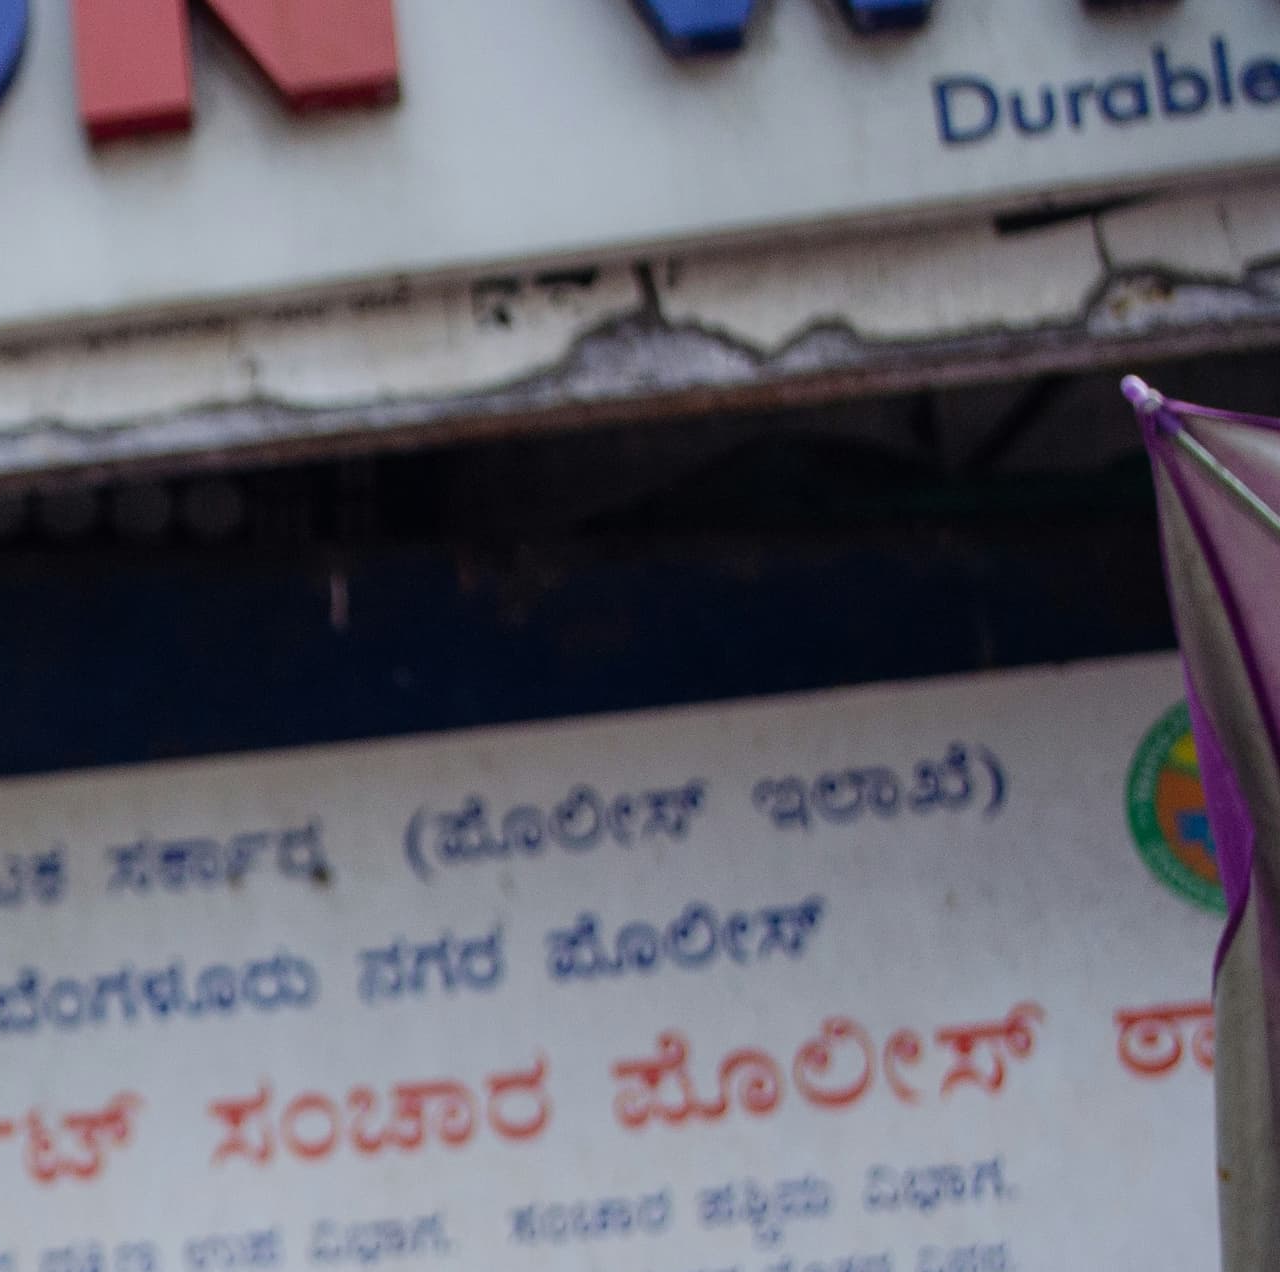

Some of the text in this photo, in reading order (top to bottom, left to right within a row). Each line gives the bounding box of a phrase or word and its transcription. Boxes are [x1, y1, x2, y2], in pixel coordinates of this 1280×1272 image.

[933, 38, 1280, 145] Durable
[212, 1054, 550, 1166] ಸಂಚಾರ
[612, 1000, 1044, 1134] ಪೊಲೀಸ್
